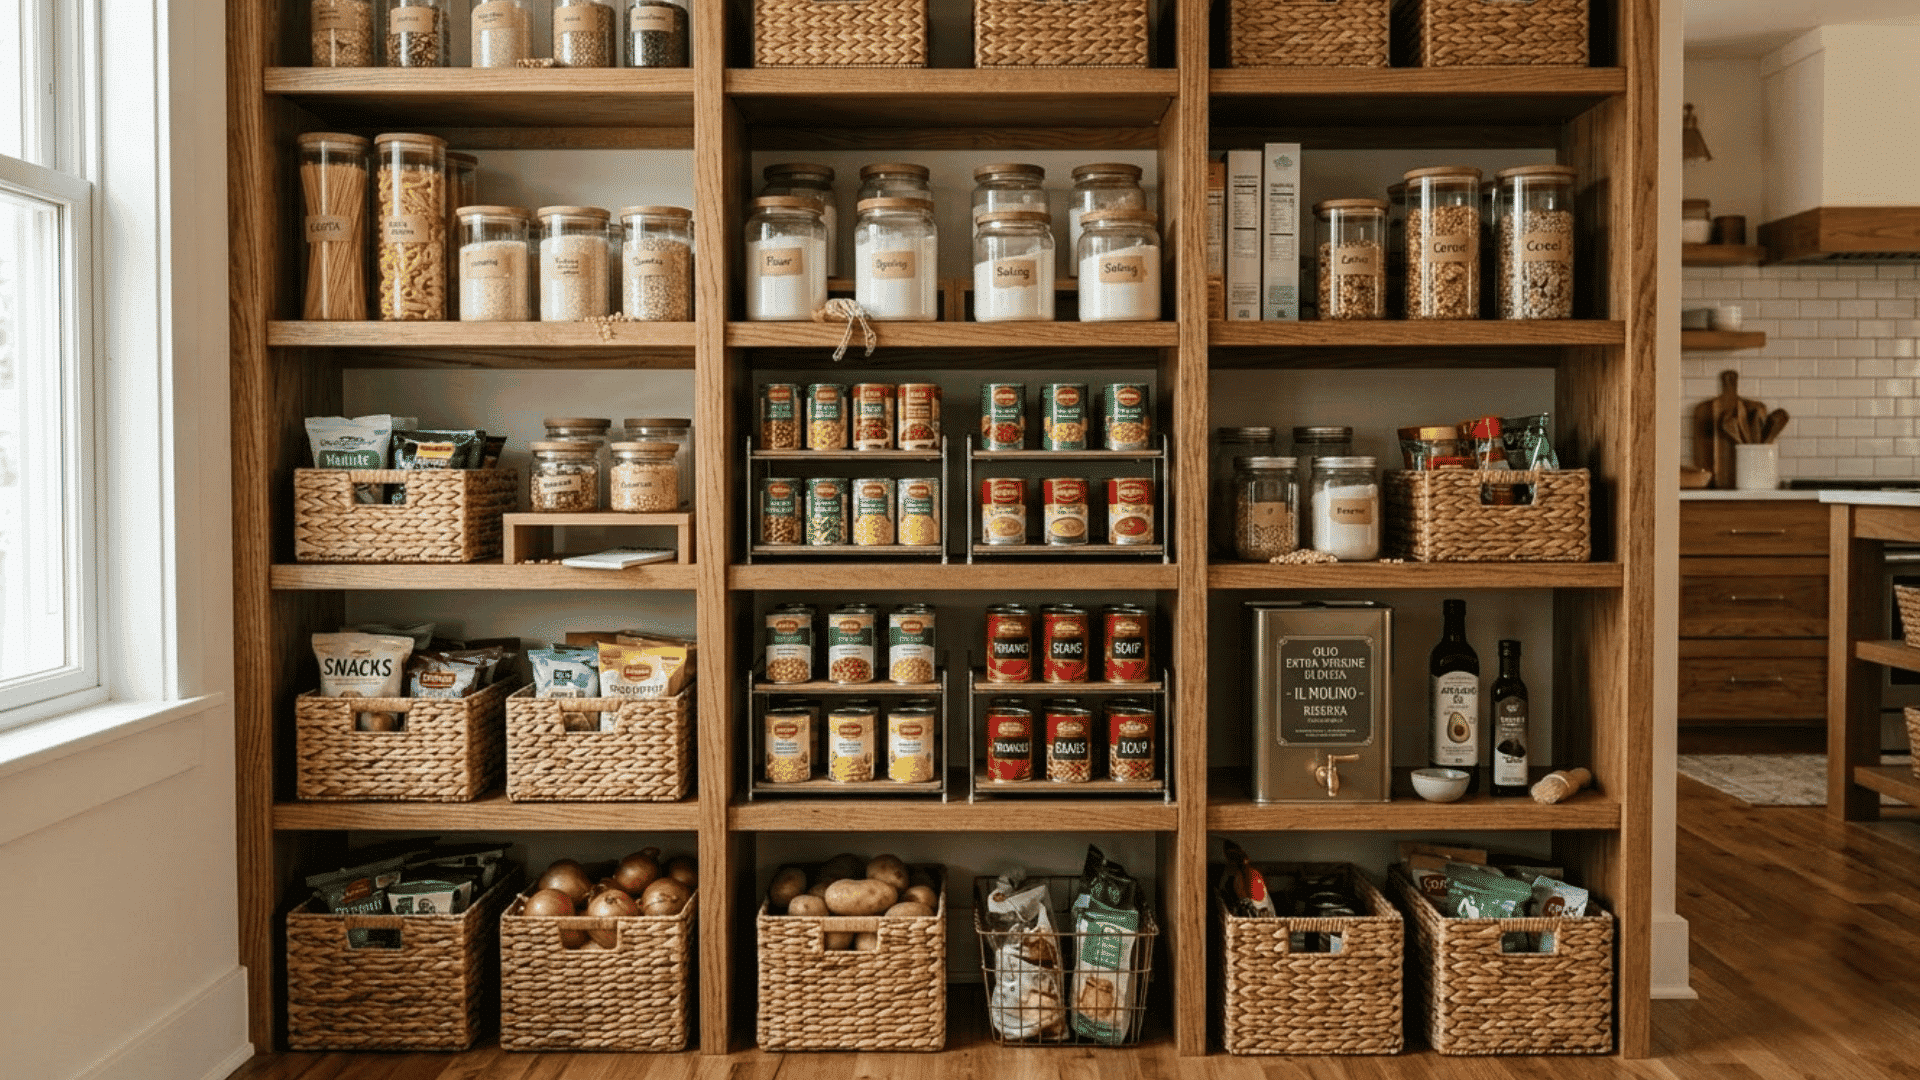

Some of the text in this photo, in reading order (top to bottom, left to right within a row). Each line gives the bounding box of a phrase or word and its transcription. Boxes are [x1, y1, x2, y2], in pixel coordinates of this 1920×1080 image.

[1312, 646, 1339, 657] OLIO
[323, 658, 393, 677] SNACKS
[1308, 687, 1357, 700] MOLINO
